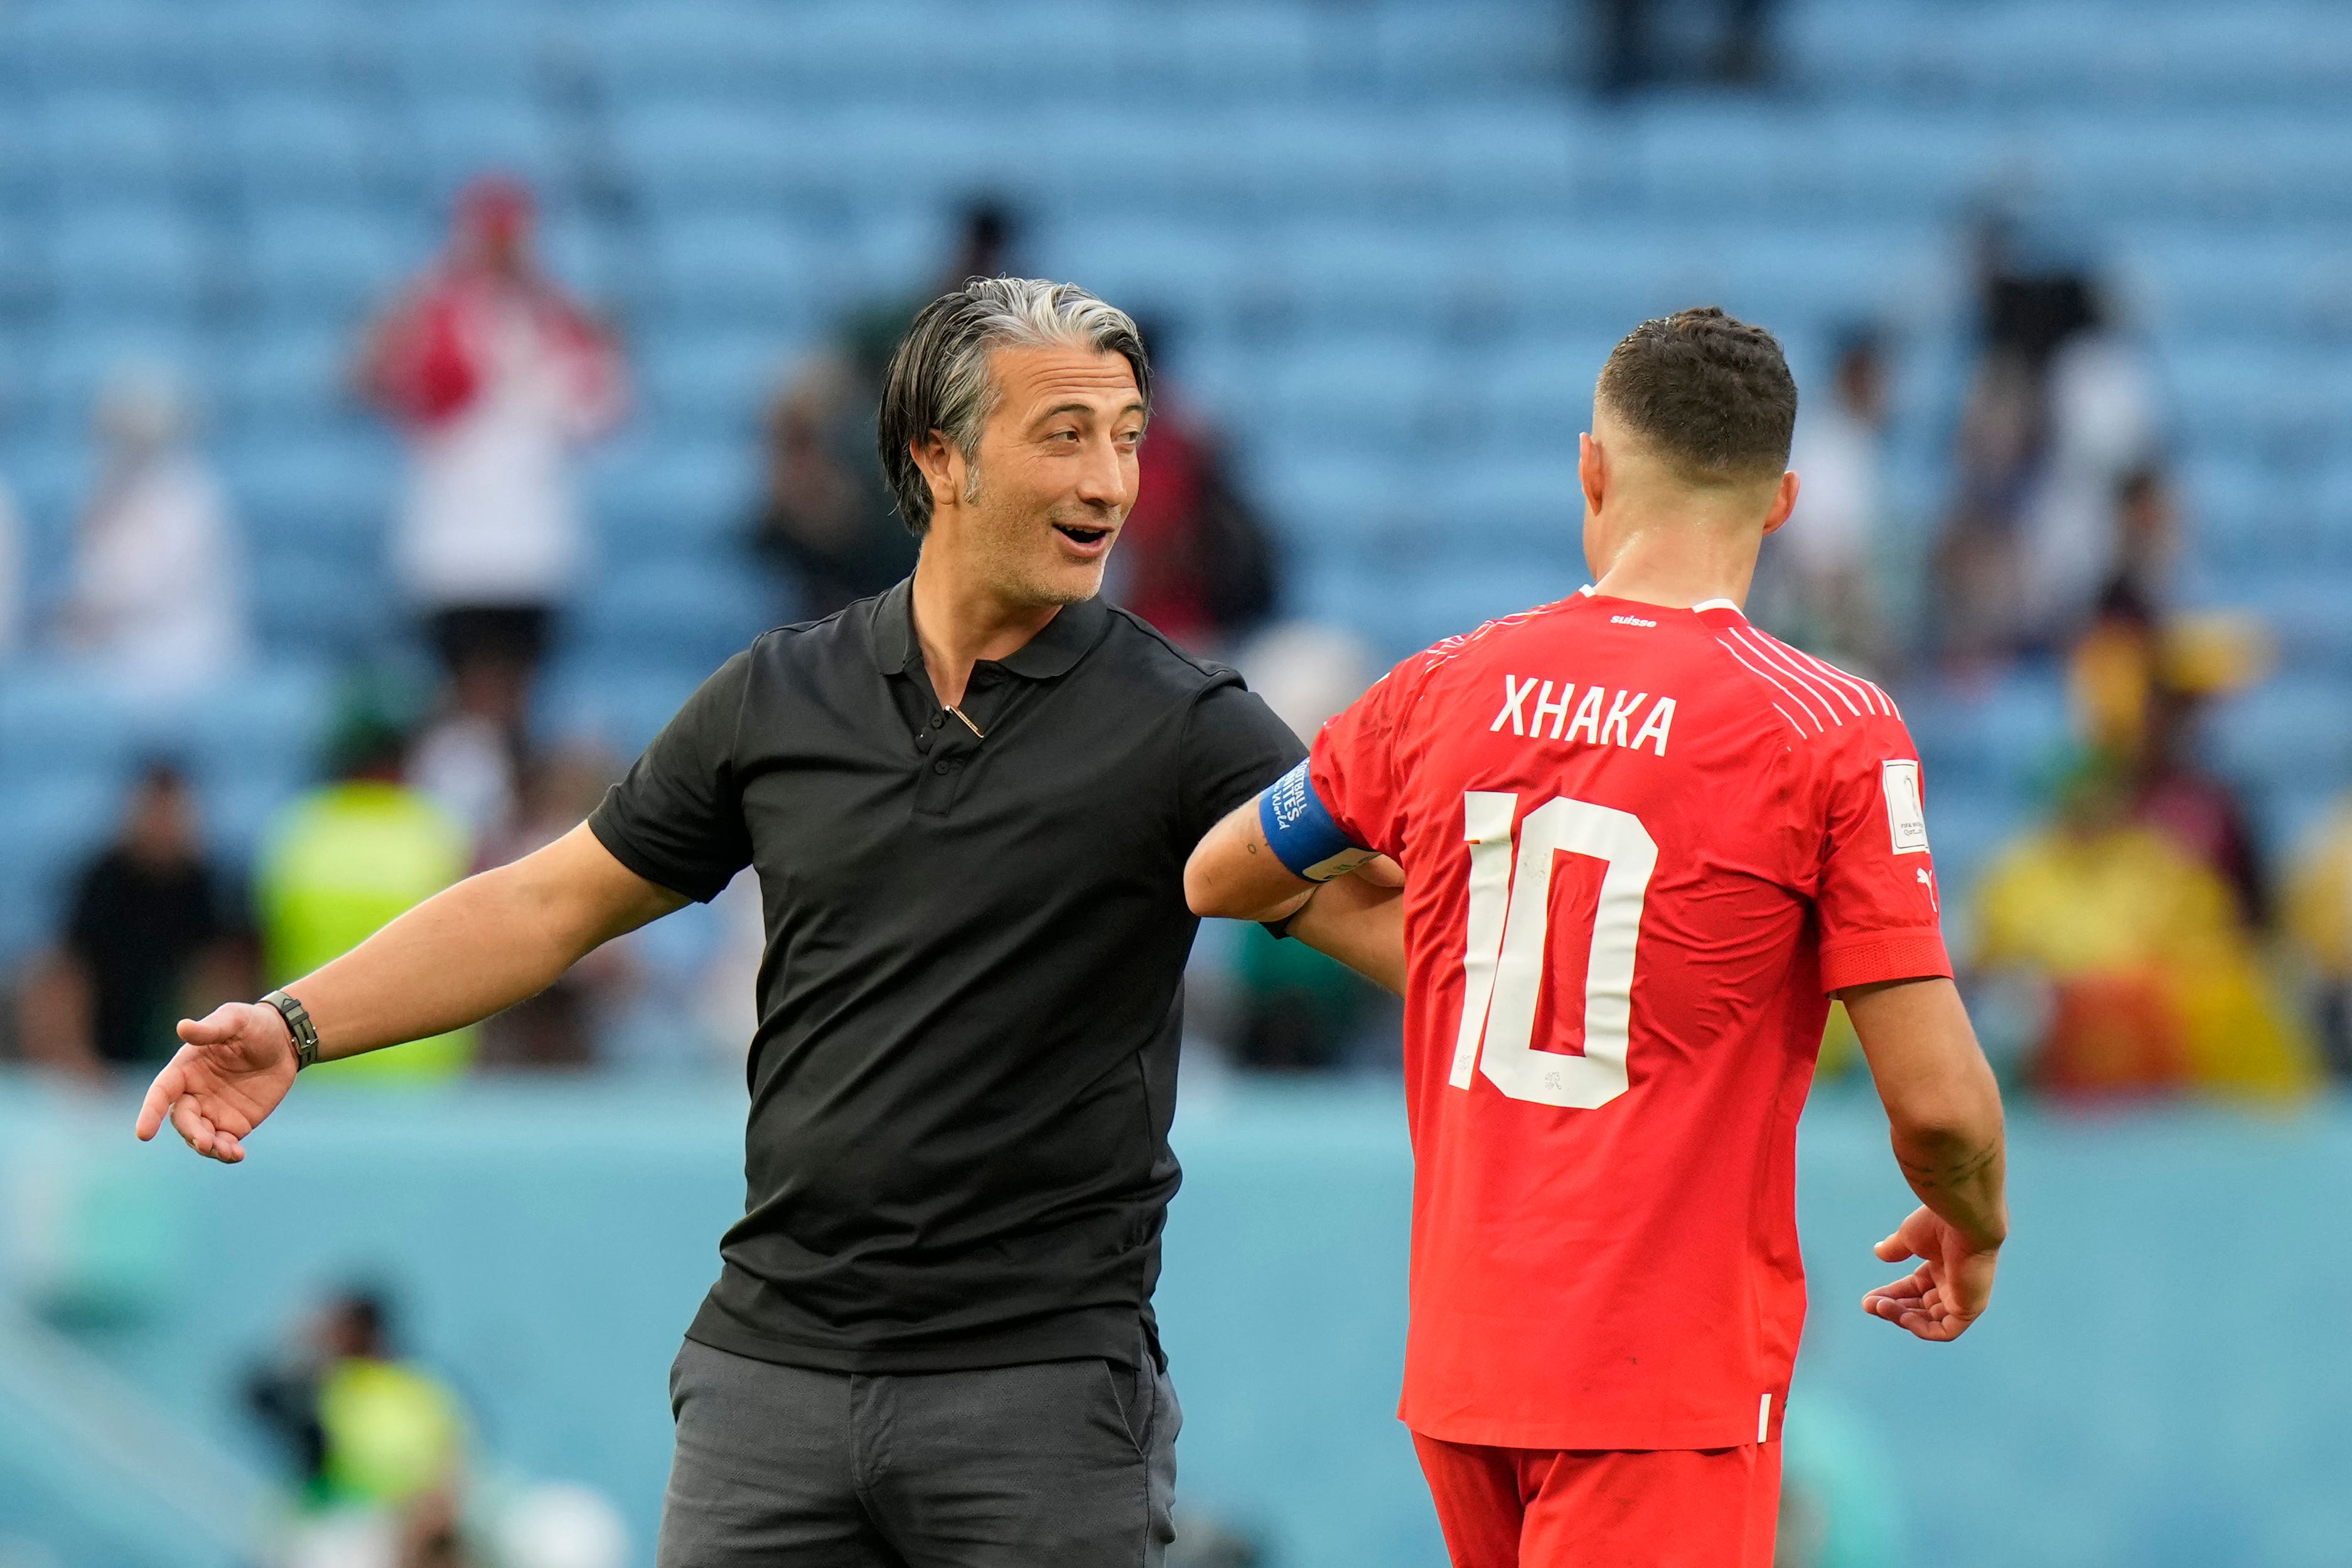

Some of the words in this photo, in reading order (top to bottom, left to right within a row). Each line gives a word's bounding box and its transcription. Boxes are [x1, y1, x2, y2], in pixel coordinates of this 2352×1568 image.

[1610, 615, 1657, 628] suisse
[1490, 674, 1677, 757] XHAKA
[1448, 790, 1659, 1110] 10
